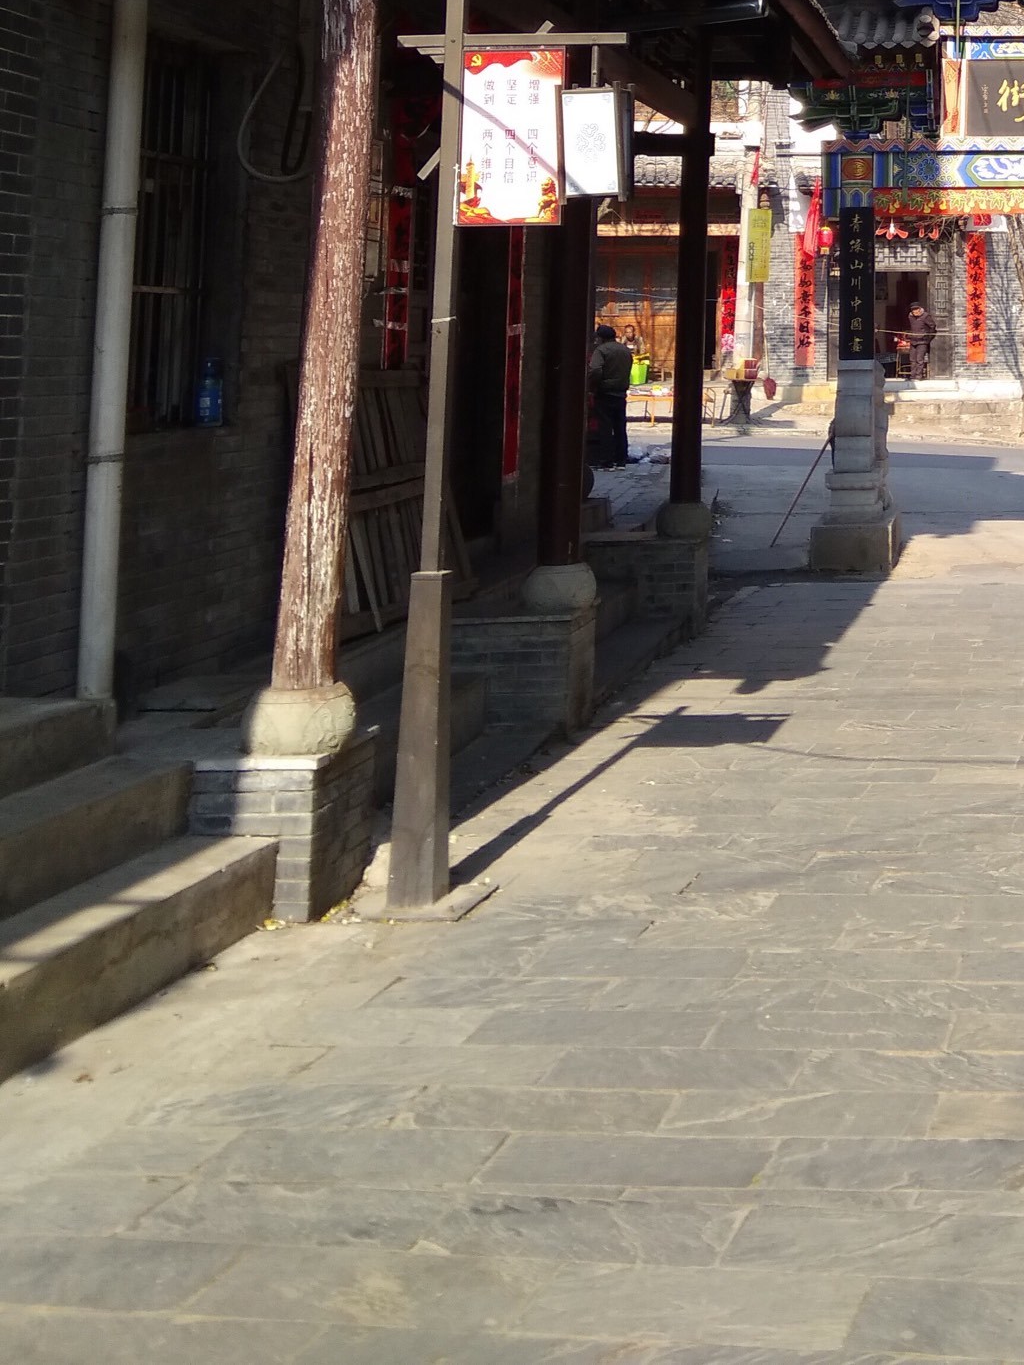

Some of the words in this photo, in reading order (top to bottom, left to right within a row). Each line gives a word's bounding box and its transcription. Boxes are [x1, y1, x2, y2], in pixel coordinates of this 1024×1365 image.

[482, 79, 496, 105] 做到
[505, 79, 518, 105] 坚定
[528, 79, 541, 105] 增强
[480, 129, 494, 184] 两个维护
[502, 128, 517, 184] 四个自信
[526, 128, 540, 183] 四个意识
[797, 248, 813, 349] 安如意千日好
